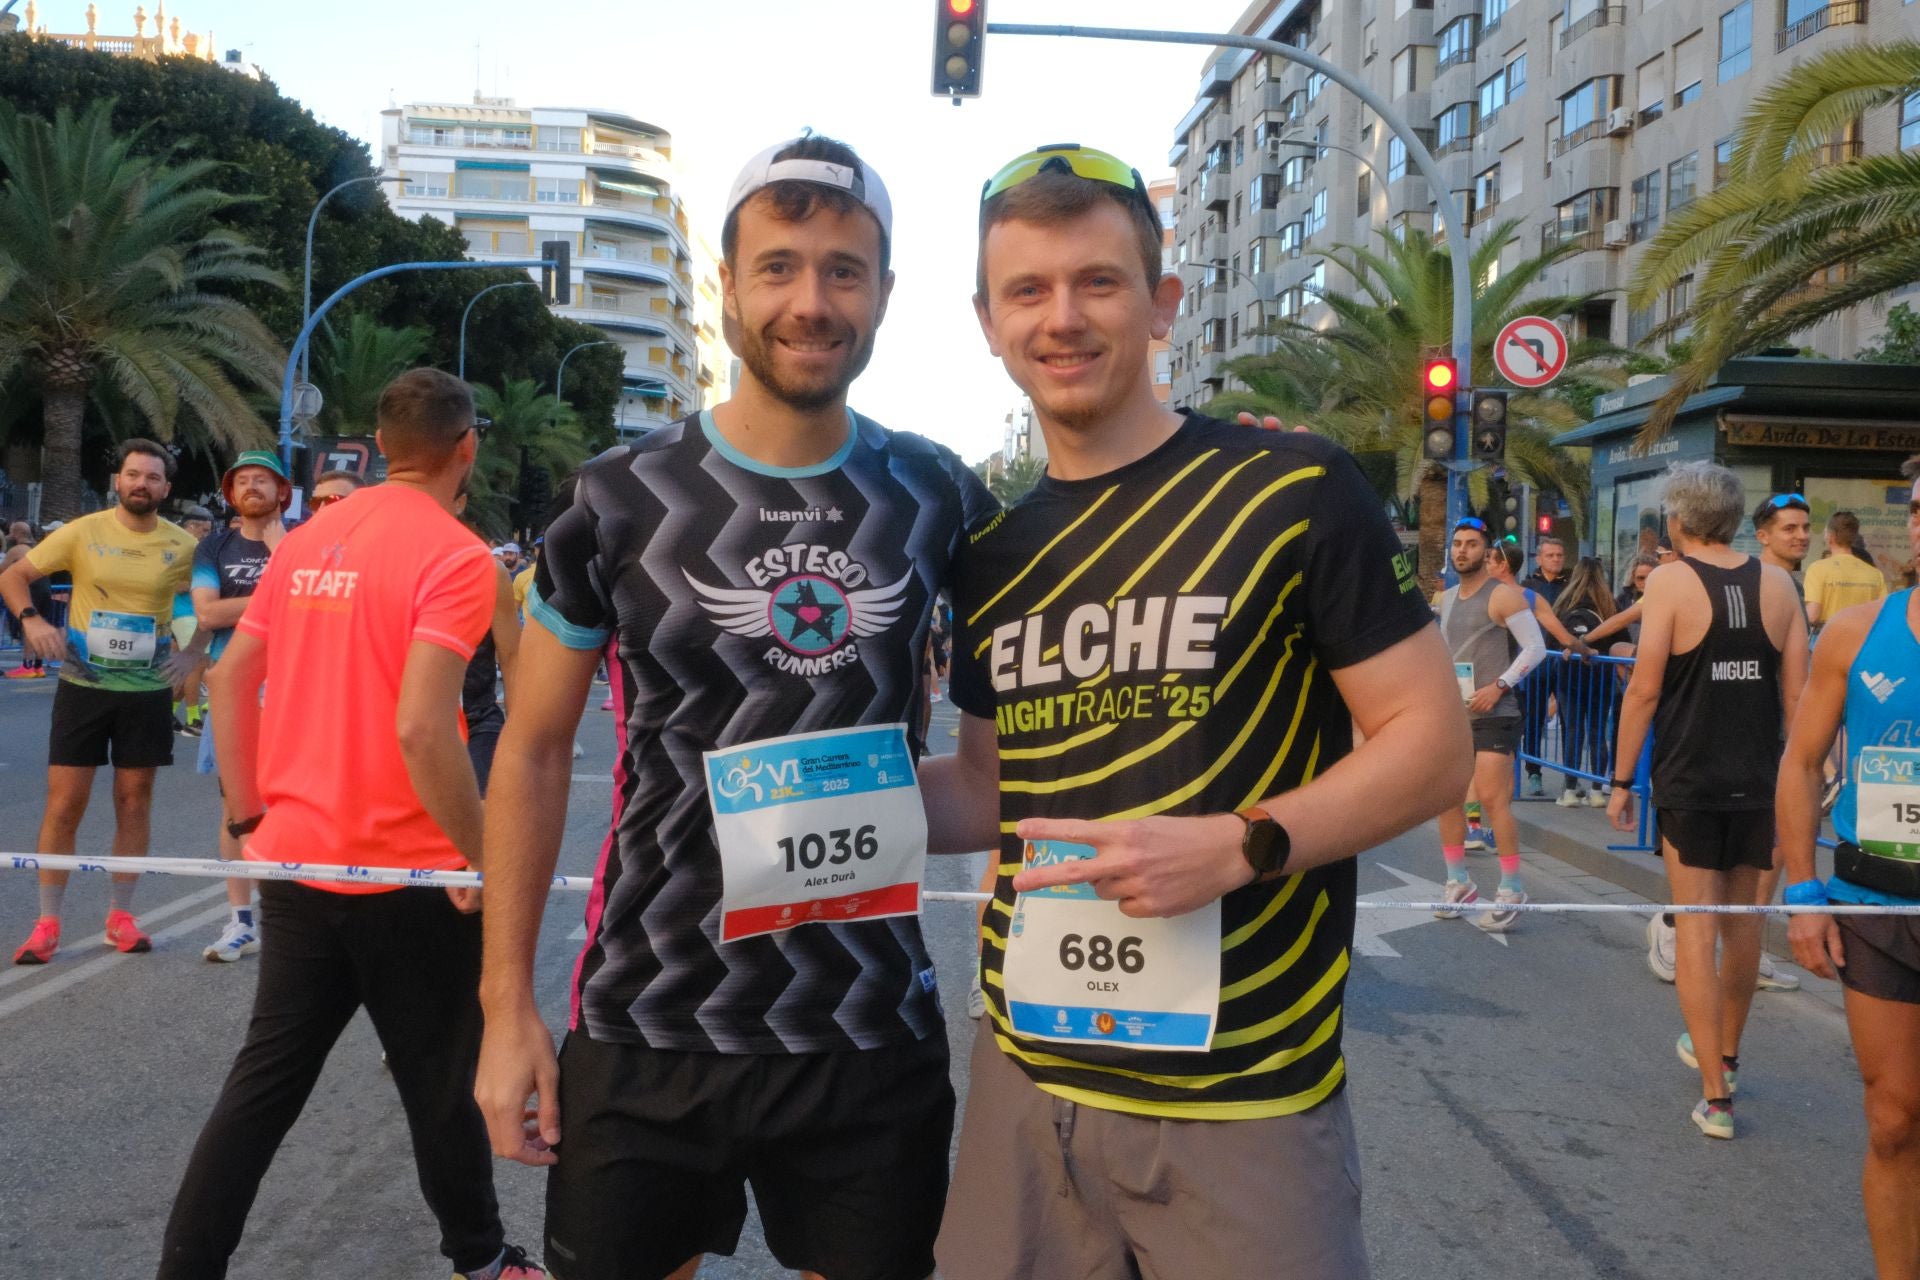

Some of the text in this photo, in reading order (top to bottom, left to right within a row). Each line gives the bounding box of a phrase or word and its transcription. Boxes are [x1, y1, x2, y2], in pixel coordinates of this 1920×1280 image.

[1760, 425, 1813, 444] Avda.
[1819, 428, 1840, 446] De
[1847, 429, 1870, 447] La
[759, 507, 821, 522] luanvi
[969, 512, 1006, 545] luanvi
[745, 543, 868, 588] ESTESO
[290, 568, 359, 599] STAFF
[108, 639, 134, 651] 981
[990, 595, 1228, 692] ELCHE
[762, 644, 859, 677] RUNNERS
[1711, 660, 1762, 681] MIGUEL
[1162, 685, 1212, 719] '25
[766, 758, 802, 787] VI
[822, 778, 850, 792] 2025
[777, 824, 879, 873] 1036
[804, 875, 828, 888] Alex
[1059, 933, 1145, 974] 686
[1086, 981, 1120, 993] OLEX
